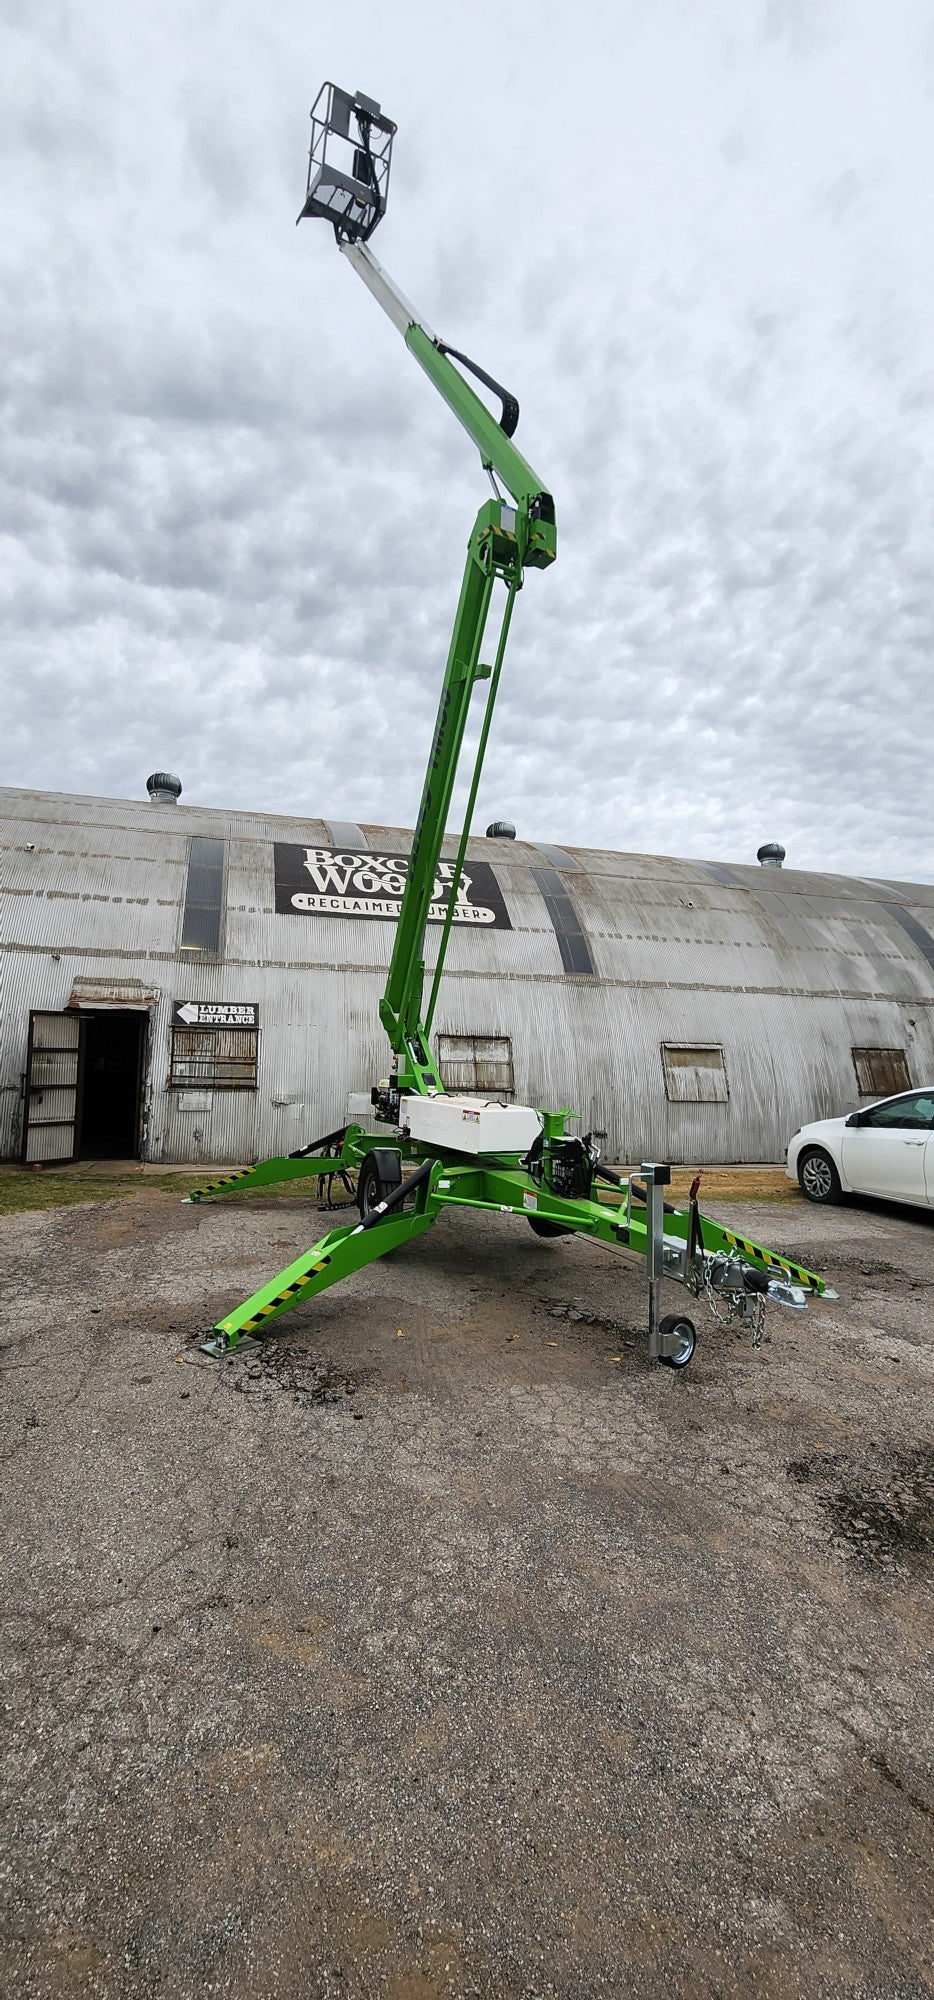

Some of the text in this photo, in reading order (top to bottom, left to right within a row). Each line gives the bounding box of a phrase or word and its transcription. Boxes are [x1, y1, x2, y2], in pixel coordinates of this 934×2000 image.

[302, 848, 471, 880] BOXCR
[427, 906, 481, 919] UMBER
[199, 1004, 255, 1015] LUMBER
[198, 1014, 255, 1024] ENTRANCE
